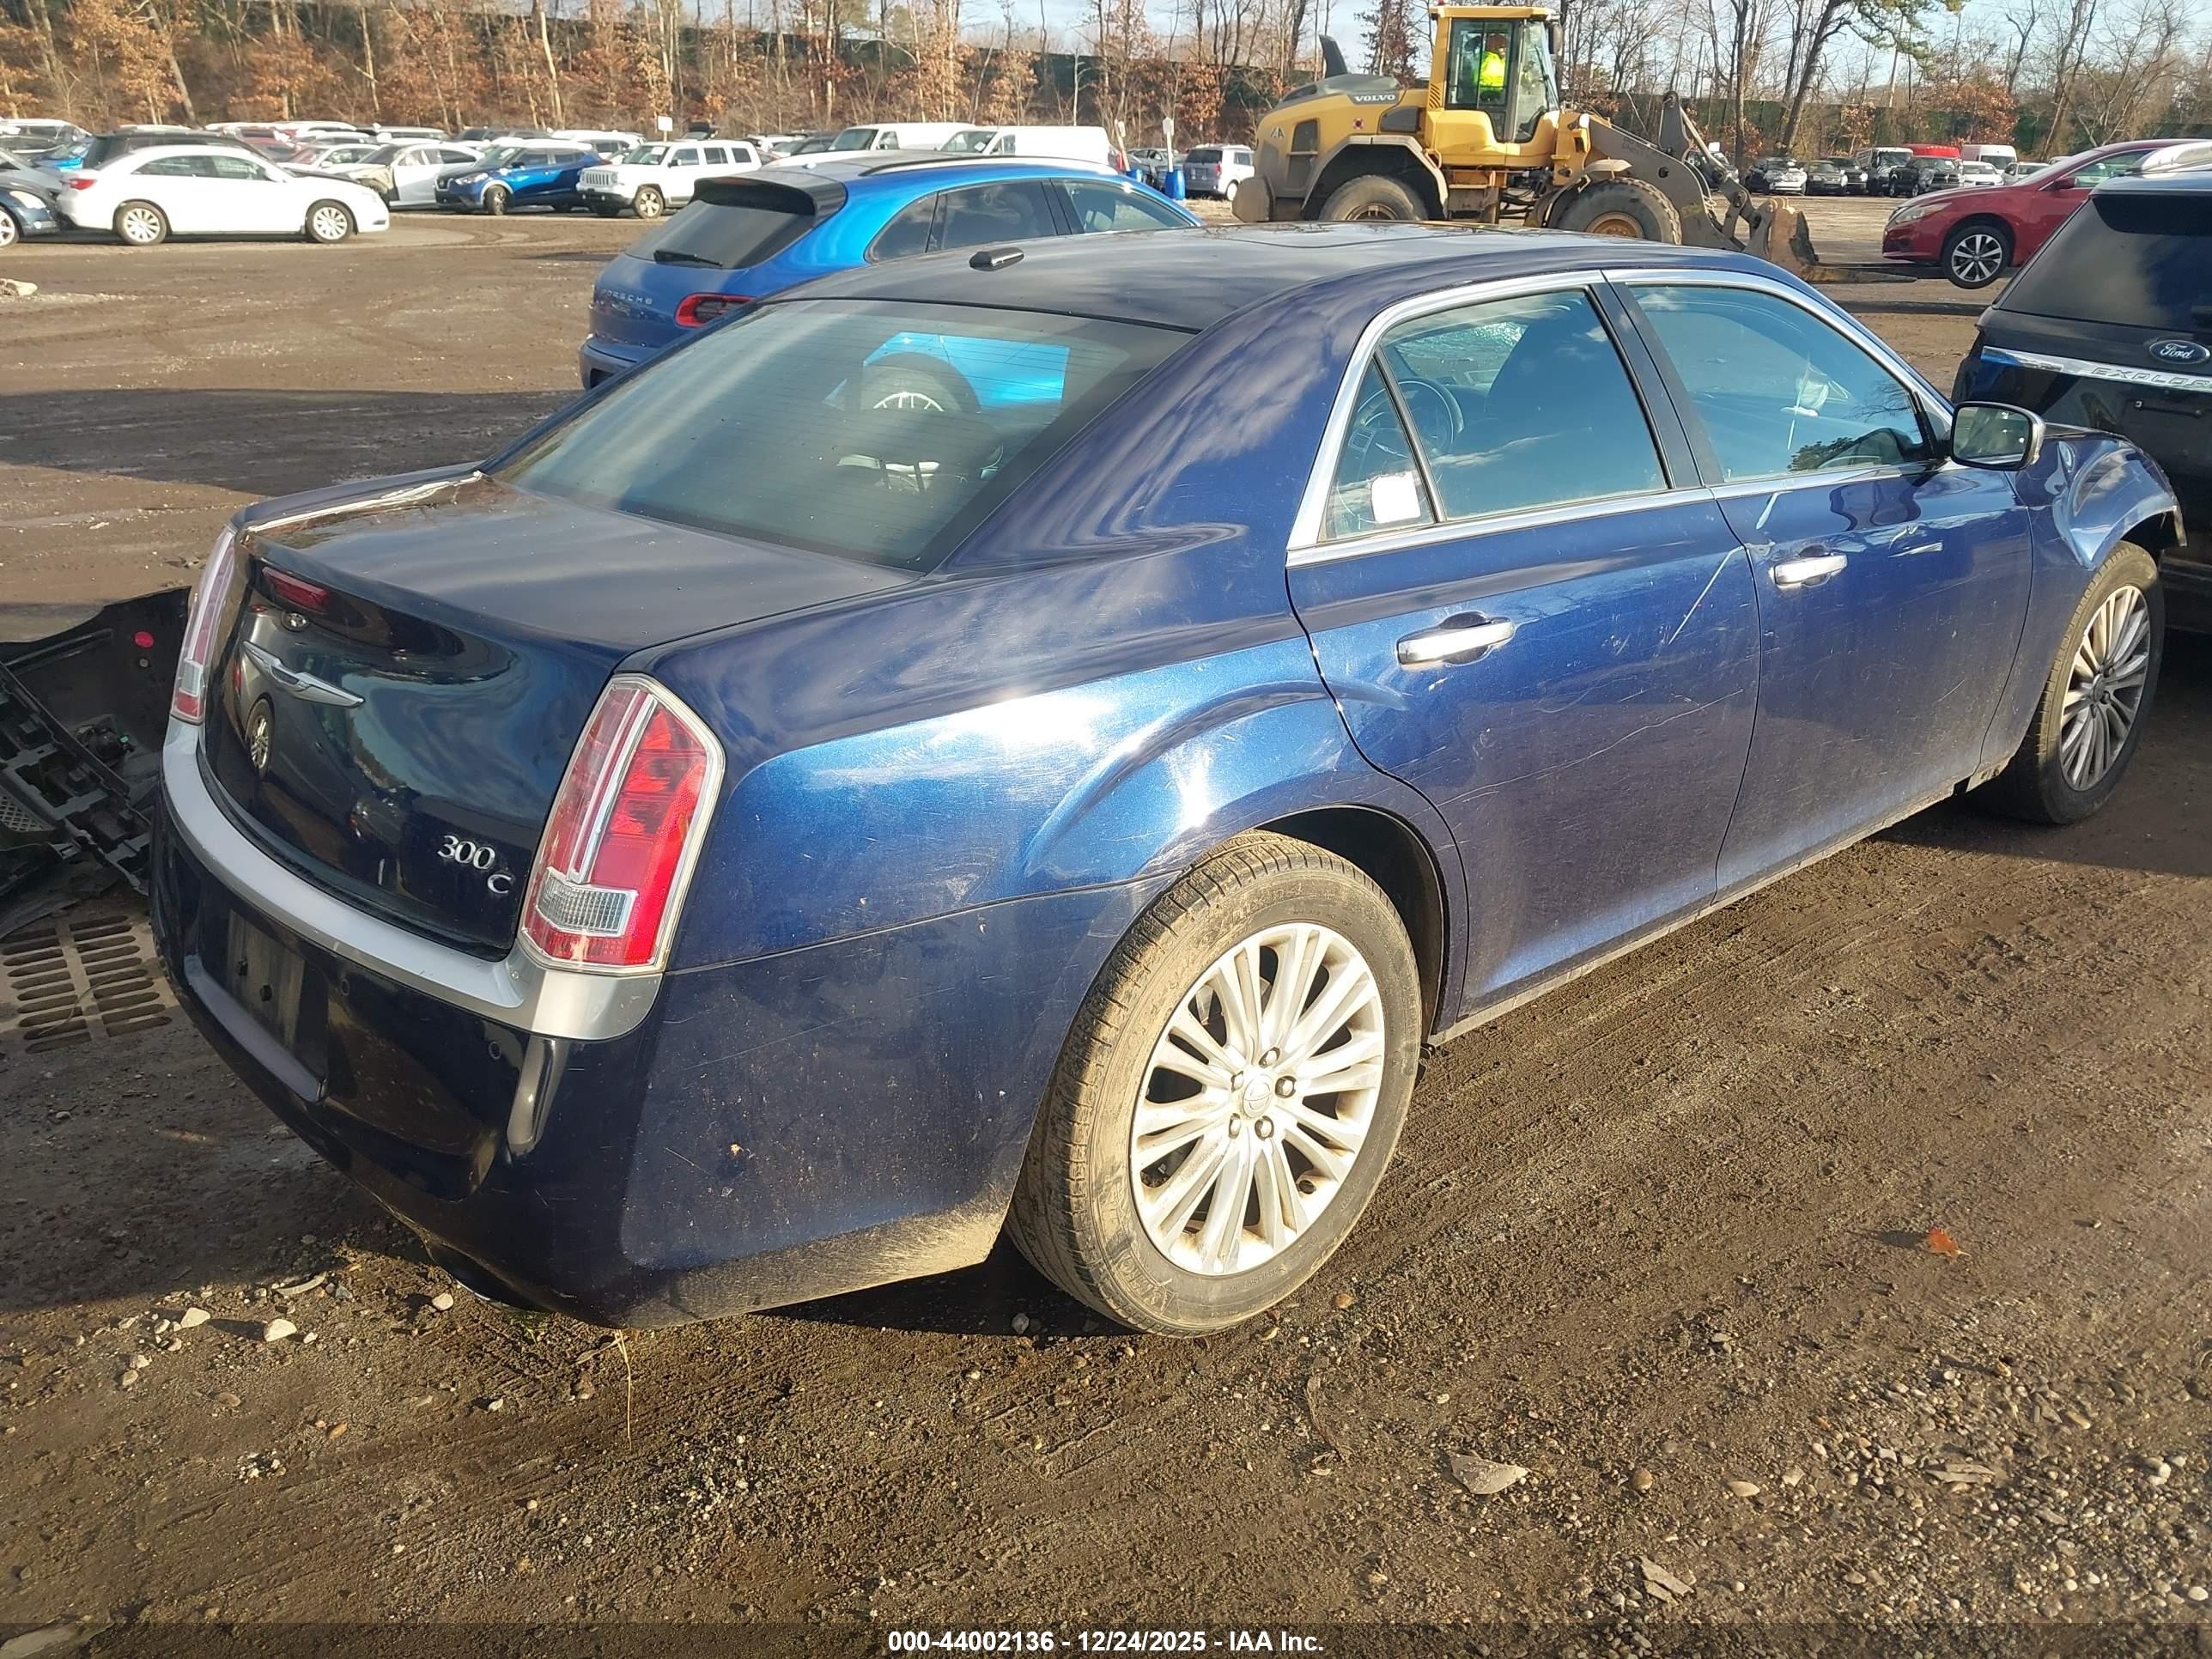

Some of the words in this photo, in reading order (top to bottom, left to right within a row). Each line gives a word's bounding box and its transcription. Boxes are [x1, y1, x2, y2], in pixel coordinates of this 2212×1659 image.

[2159, 343, 2195, 360] Ford
[437, 835, 495, 870] 300
[487, 873, 513, 894] C
